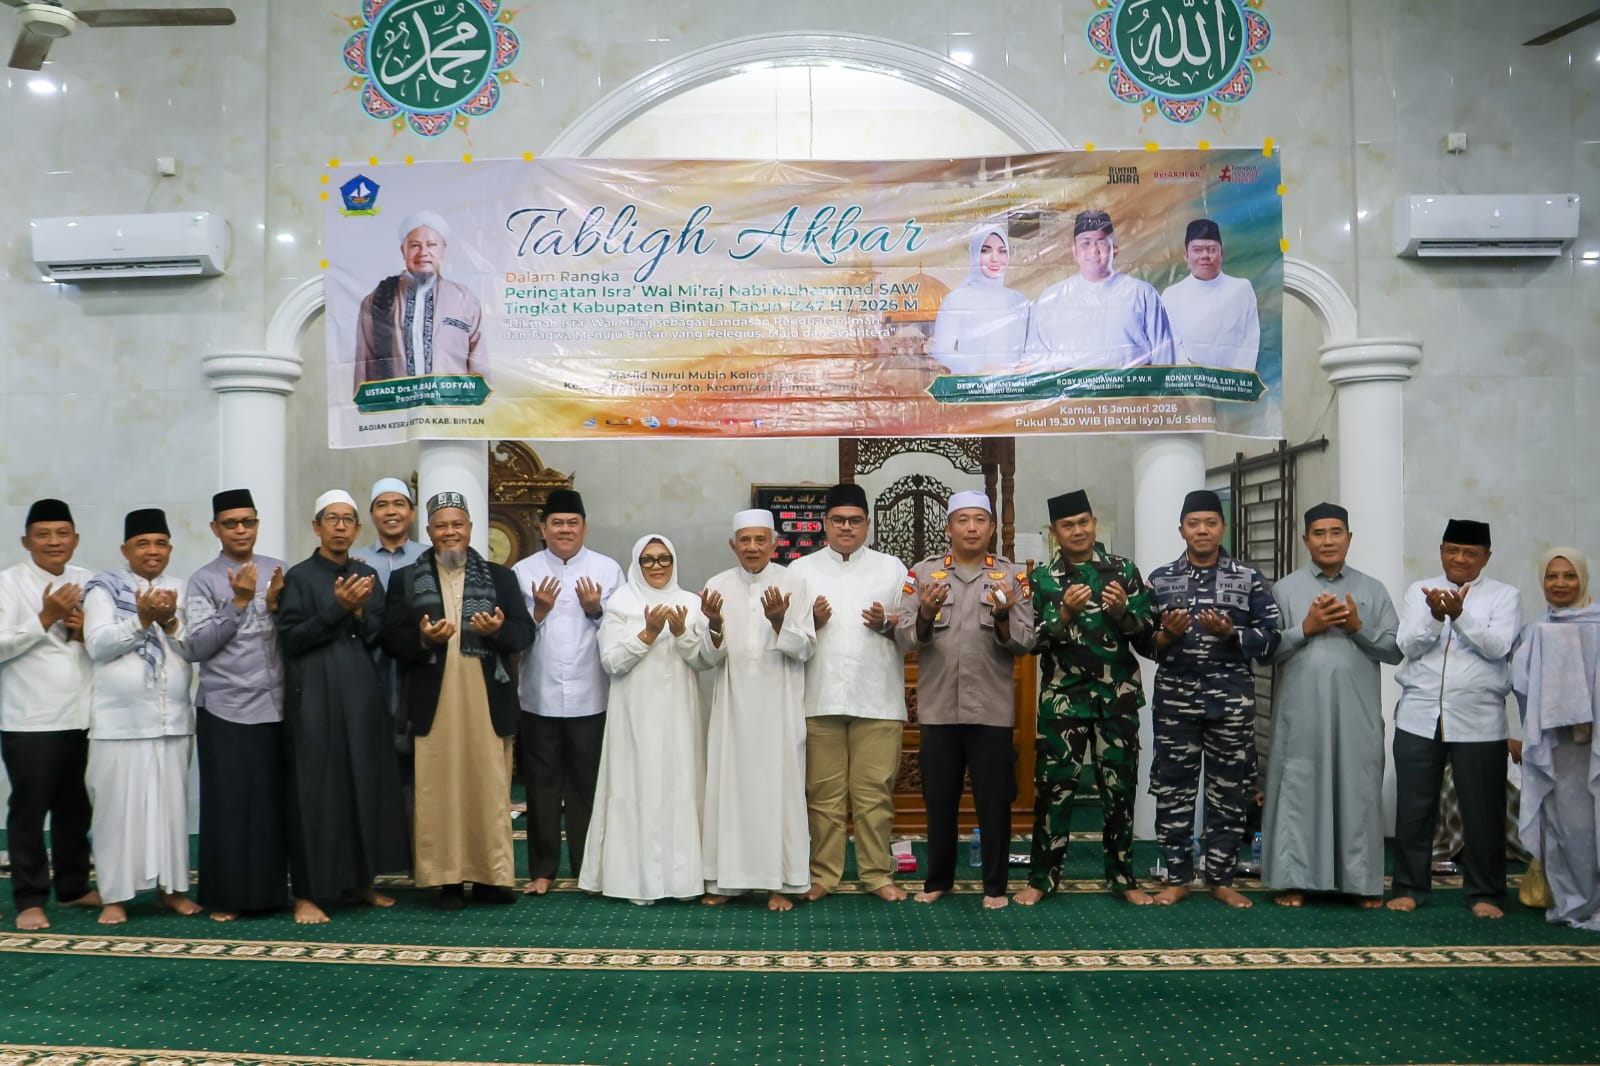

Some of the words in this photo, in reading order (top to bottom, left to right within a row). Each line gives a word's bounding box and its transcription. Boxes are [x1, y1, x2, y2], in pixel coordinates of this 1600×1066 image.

[1107, 174, 1139, 184] JUARA
[505, 204, 716, 284] Tabligh
[728, 204, 929, 265] Akbar
[505, 271, 555, 283] Dalam
[560, 271, 620, 284] Rangka
[505, 286, 597, 301] Peringatan
[602, 285, 636, 298] Isra'
[641, 285, 673, 297] Wal
[678, 284, 723, 299] Mi'raj
[729, 284, 767, 297] Nabi
[772, 283, 874, 297] Muhammad
[879, 282, 919, 295] SAW
[505, 301, 568, 317] Tingkat
[573, 301, 664, 316] Kabupaten
[670, 300, 725, 313] Bintan
[730, 300, 783, 313] Tahun
[831, 300, 842, 312] H
[847, 299, 854, 312] /
[858, 299, 898, 311] 2026
[903, 299, 919, 311] M
[655, 318, 706, 330] sebagai
[709, 317, 770, 328] Landasan
[504, 330, 528, 340] dan
[626, 329, 668, 339] Bintan
[671, 330, 703, 341] yang
[651, 371, 684, 380] Nurul
[688, 371, 726, 380] Mubin
[730, 371, 773, 382] Kolong
[1165, 374, 1192, 382] RONNY
[365, 387, 396, 397] USTADZ
[440, 381, 476, 390] SOFYAN
[672, 383, 703, 392] Kota,
[1060, 405, 1096, 416] Kamis,
[1098, 405, 1108, 414] 15
[1110, 404, 1149, 414] Januari
[1152, 404, 1178, 413] 2026
[359, 424, 387, 432] BAGIAN
[433, 417, 453, 425] KAB.
[453, 417, 485, 425] BINTAN
[1015, 417, 1047, 428] Pukul
[1049, 417, 1076, 427] 19.30
[1078, 417, 1101, 426] WIB
[1104, 415, 1137, 426] (Ba'da
[1166, 414, 1182, 424] s/d
